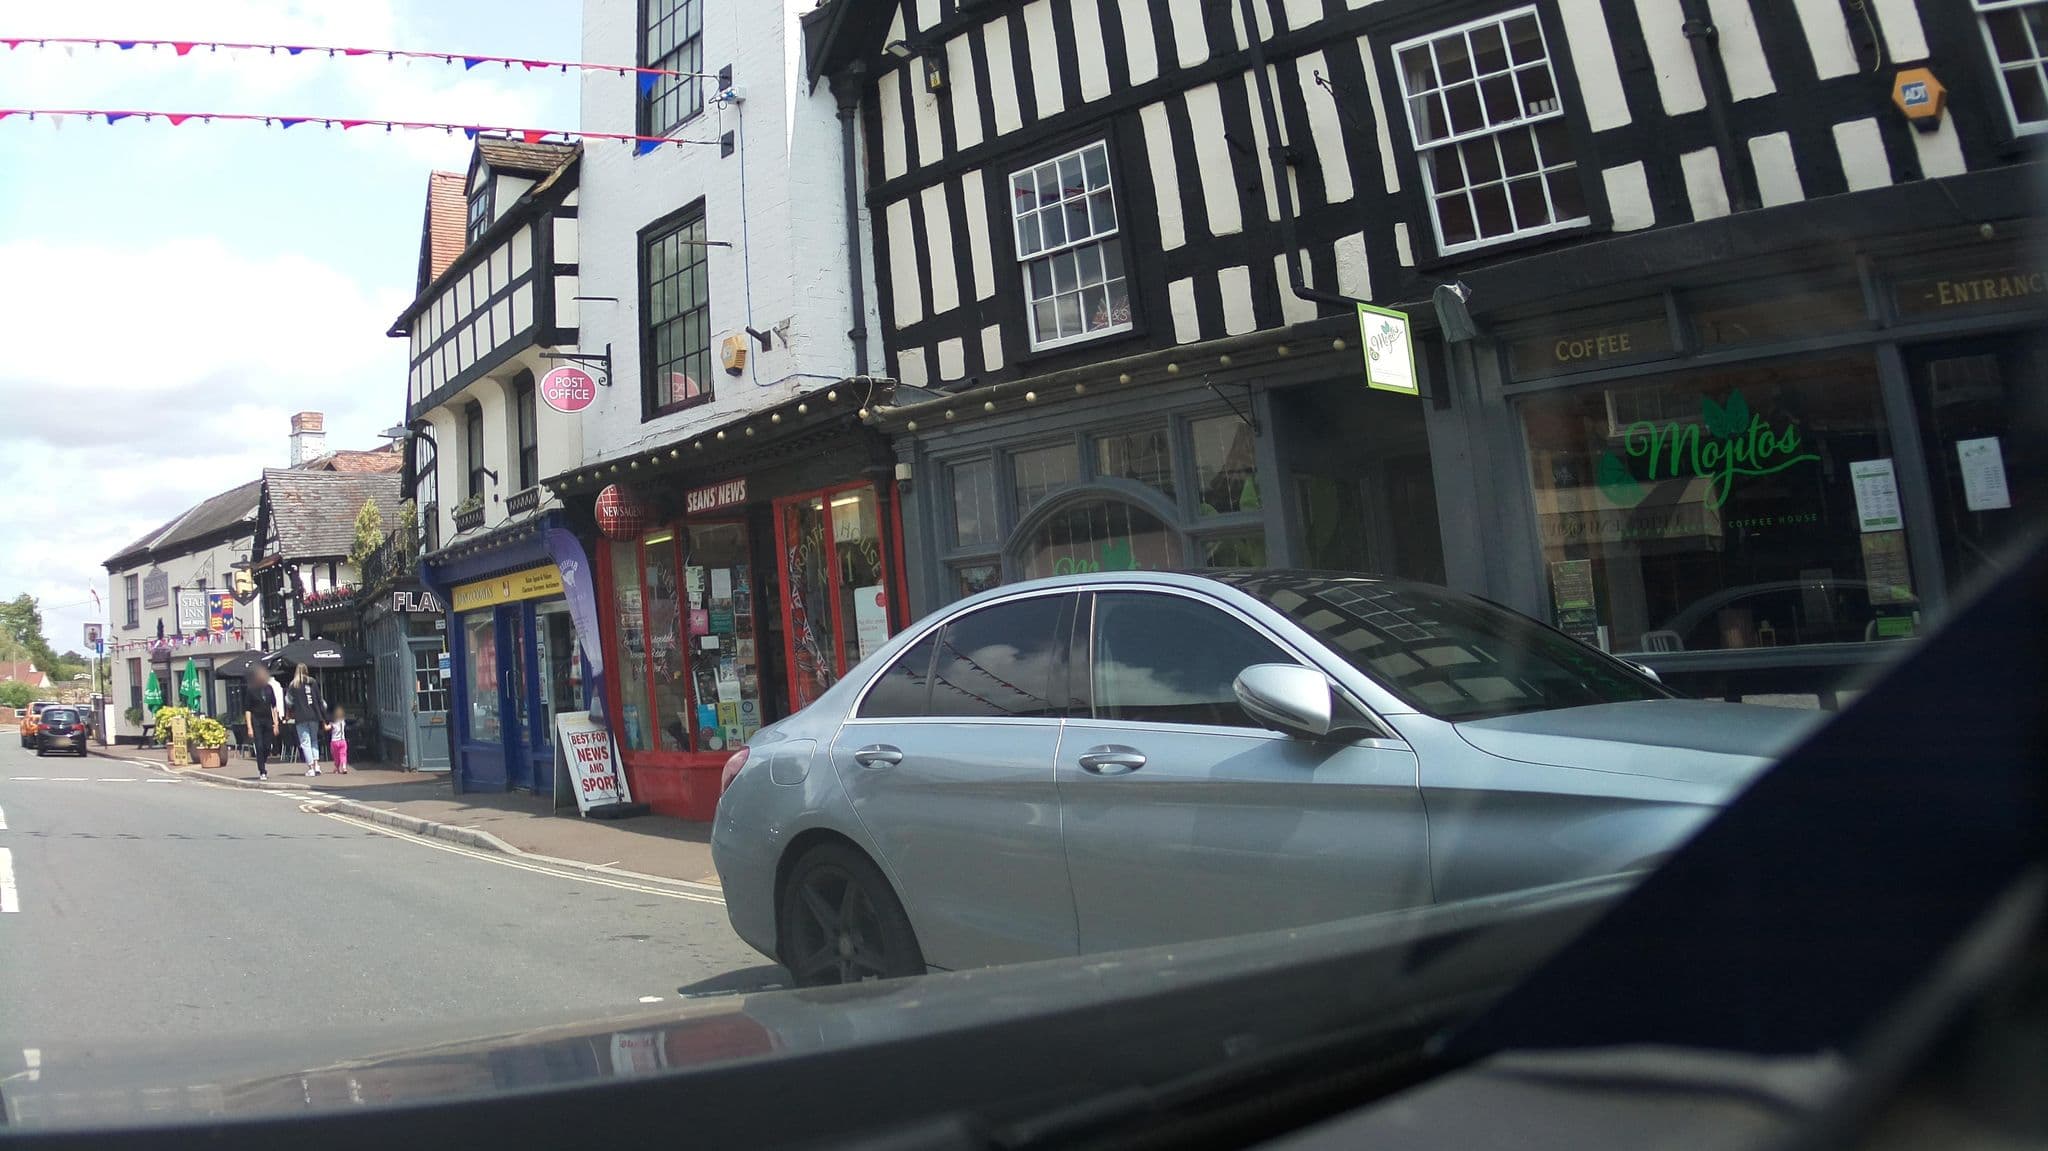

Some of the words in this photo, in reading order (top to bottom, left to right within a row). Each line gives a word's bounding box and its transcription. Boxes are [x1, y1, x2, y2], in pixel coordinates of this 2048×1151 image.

[1555, 333, 1632, 361] COFFEE
[555, 376, 585, 388] POST
[548, 388, 590, 400] OFFICE
[1624, 413, 1821, 511] Mojitos
[718, 480, 746, 505] NEWS
[1728, 517, 1773, 529] COFFEE
[1778, 513, 1818, 525] HOUSE
[182, 597, 206, 607] STAR
[185, 608, 205, 618] INN
[571, 733, 590, 745] BEST
[591, 732, 607, 743] FOR
[577, 746, 609, 762] NEWS
[589, 763, 604, 774] AND
[582, 775, 618, 792] SPORT
